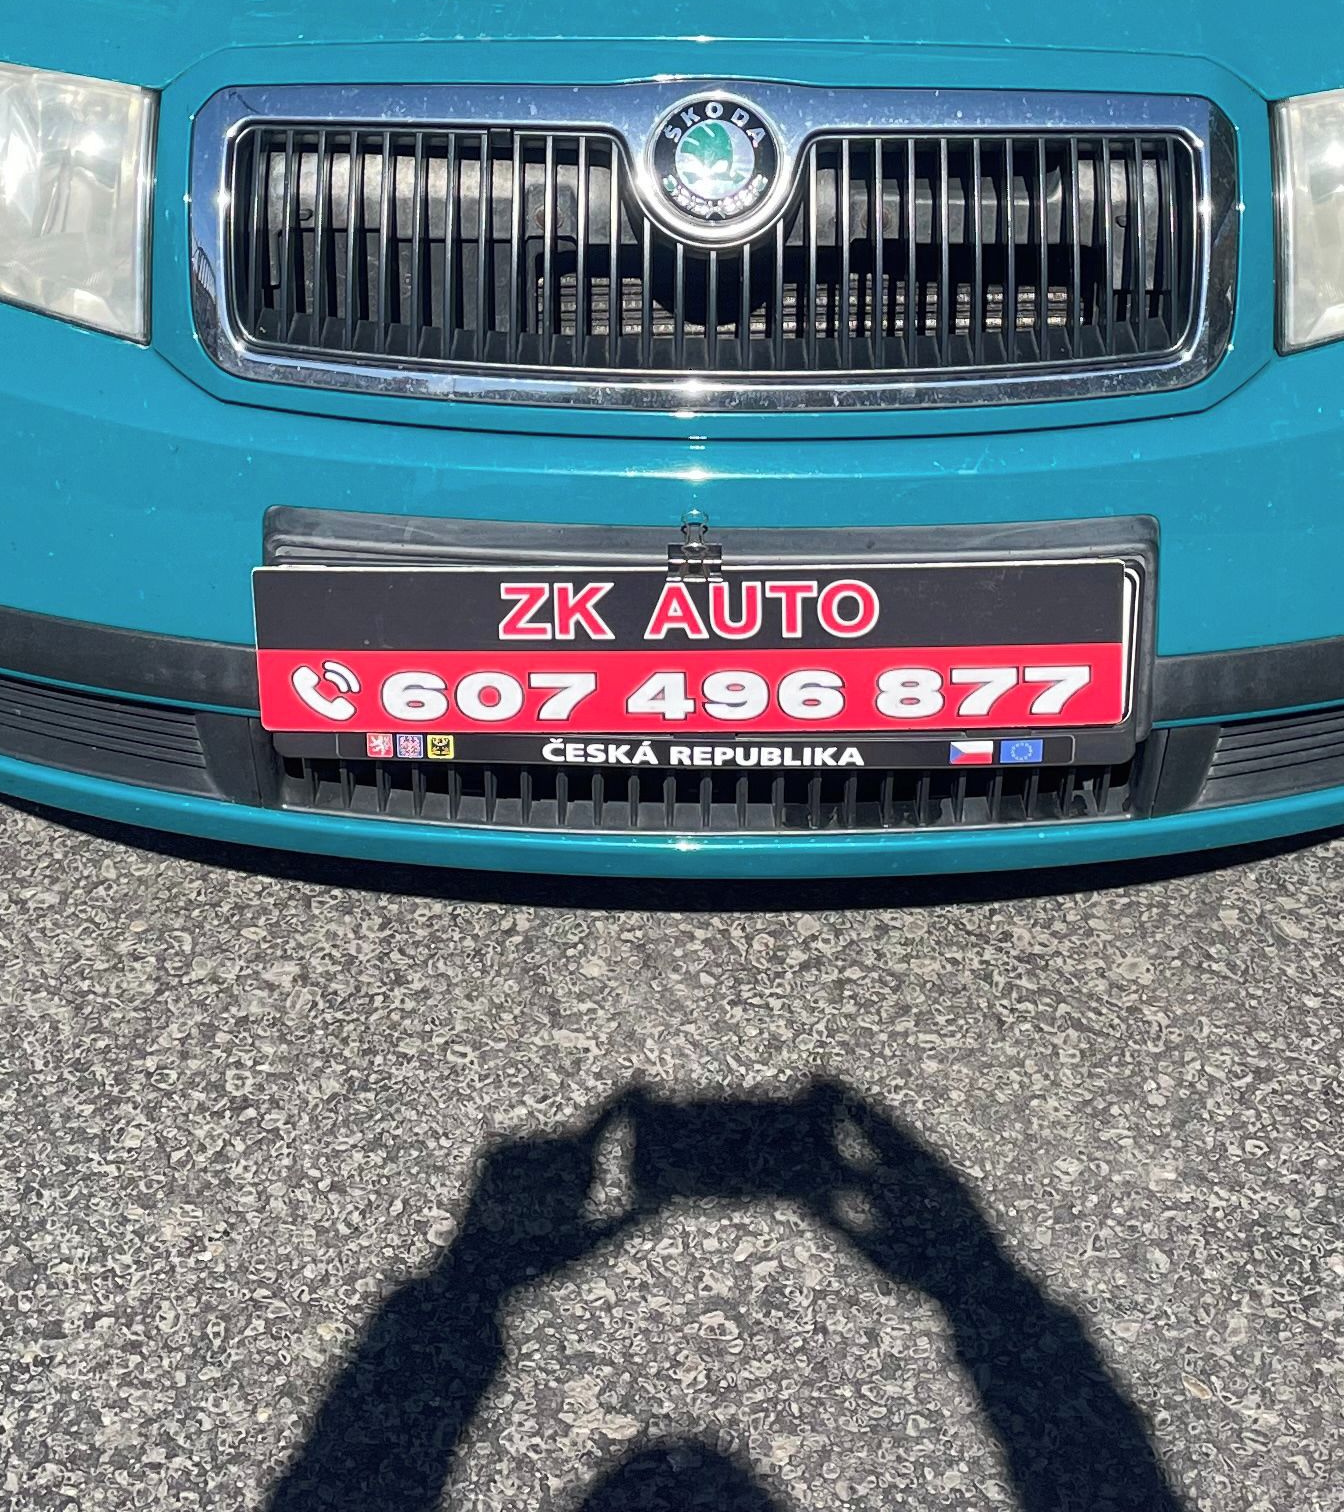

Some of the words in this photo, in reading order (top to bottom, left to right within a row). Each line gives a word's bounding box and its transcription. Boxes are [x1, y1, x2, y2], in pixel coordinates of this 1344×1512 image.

[498, 582, 615, 640] ZK
[644, 578, 880, 640] AUTO
[381, 671, 597, 722] 607
[625, 669, 846, 721] 496
[875, 665, 1092, 719] 877
[541, 737, 659, 766] ČESKÁ
[669, 745, 865, 767] REPUBLIKA
